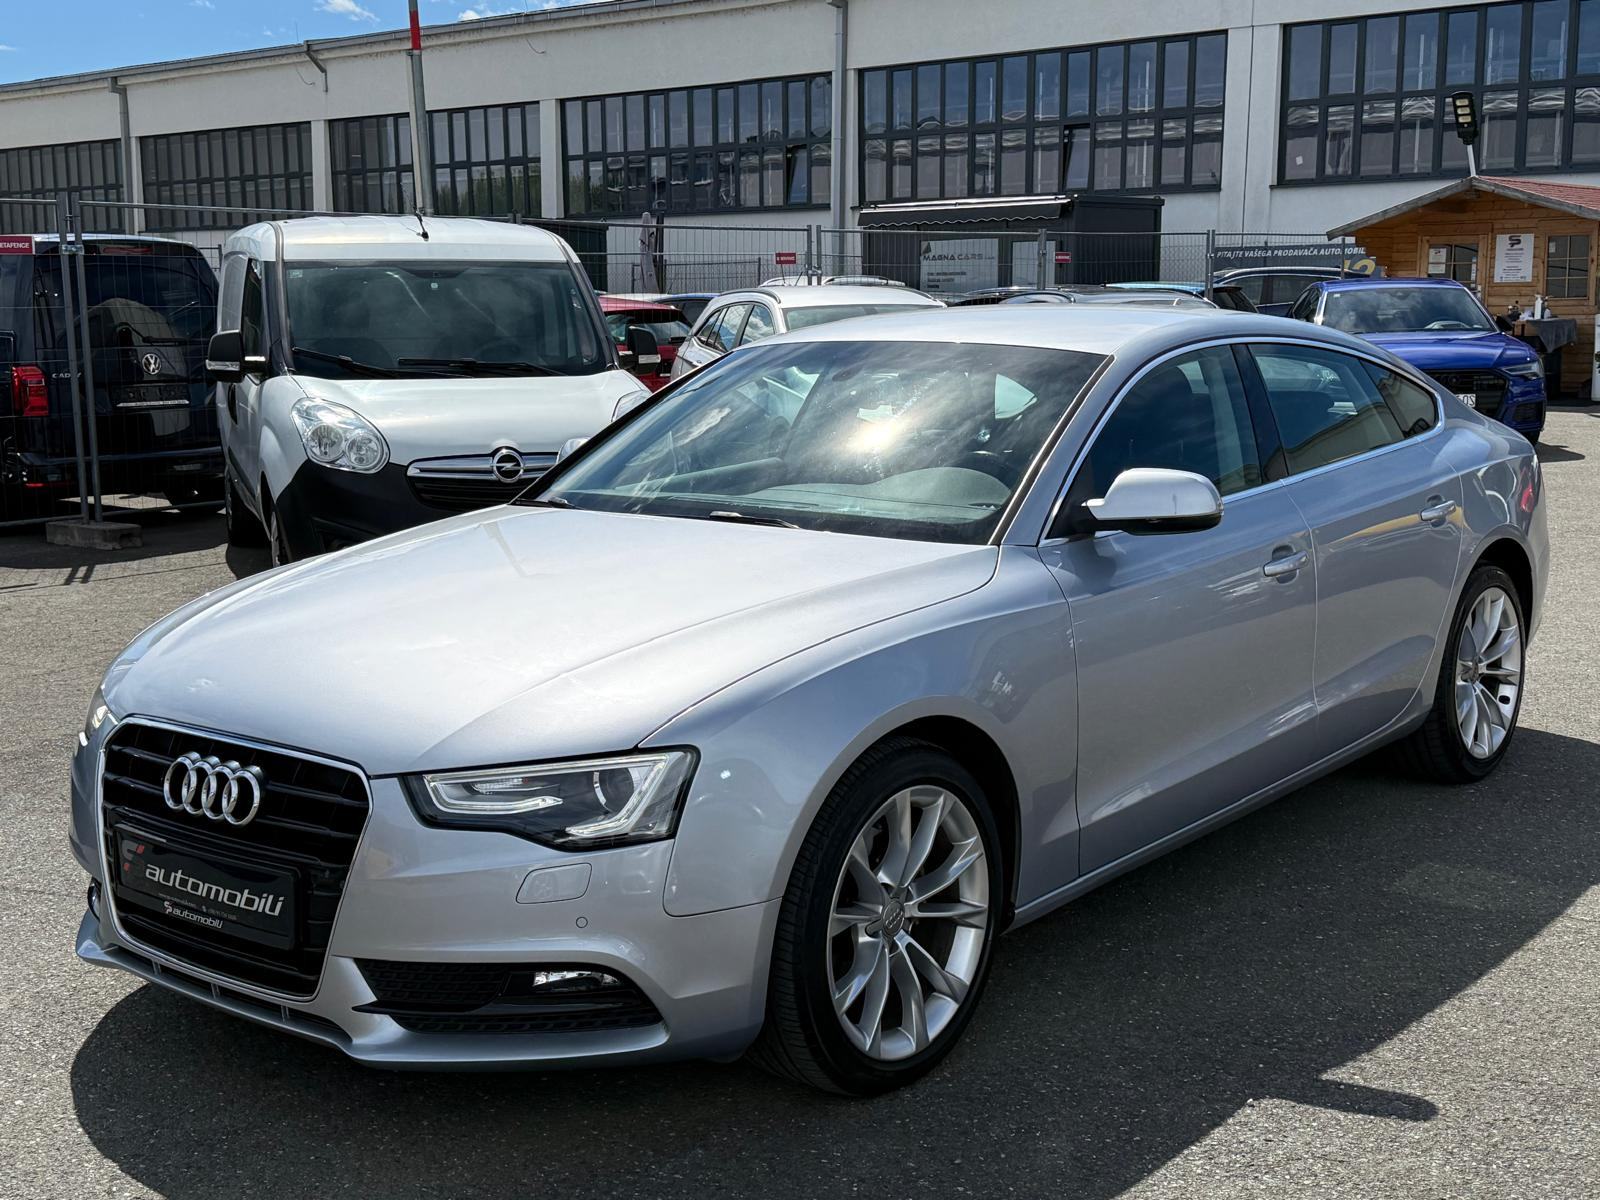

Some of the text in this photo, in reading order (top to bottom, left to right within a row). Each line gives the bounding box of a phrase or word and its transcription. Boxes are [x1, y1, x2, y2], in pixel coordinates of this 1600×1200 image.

[1217, 250, 1244, 259] PITAJTE
[1244, 249, 1272, 257] VAŠEGA
[1273, 247, 1318, 257] PRODAVAČA
[145, 863, 285, 917] automobili
[172, 907, 223, 929] automobili
